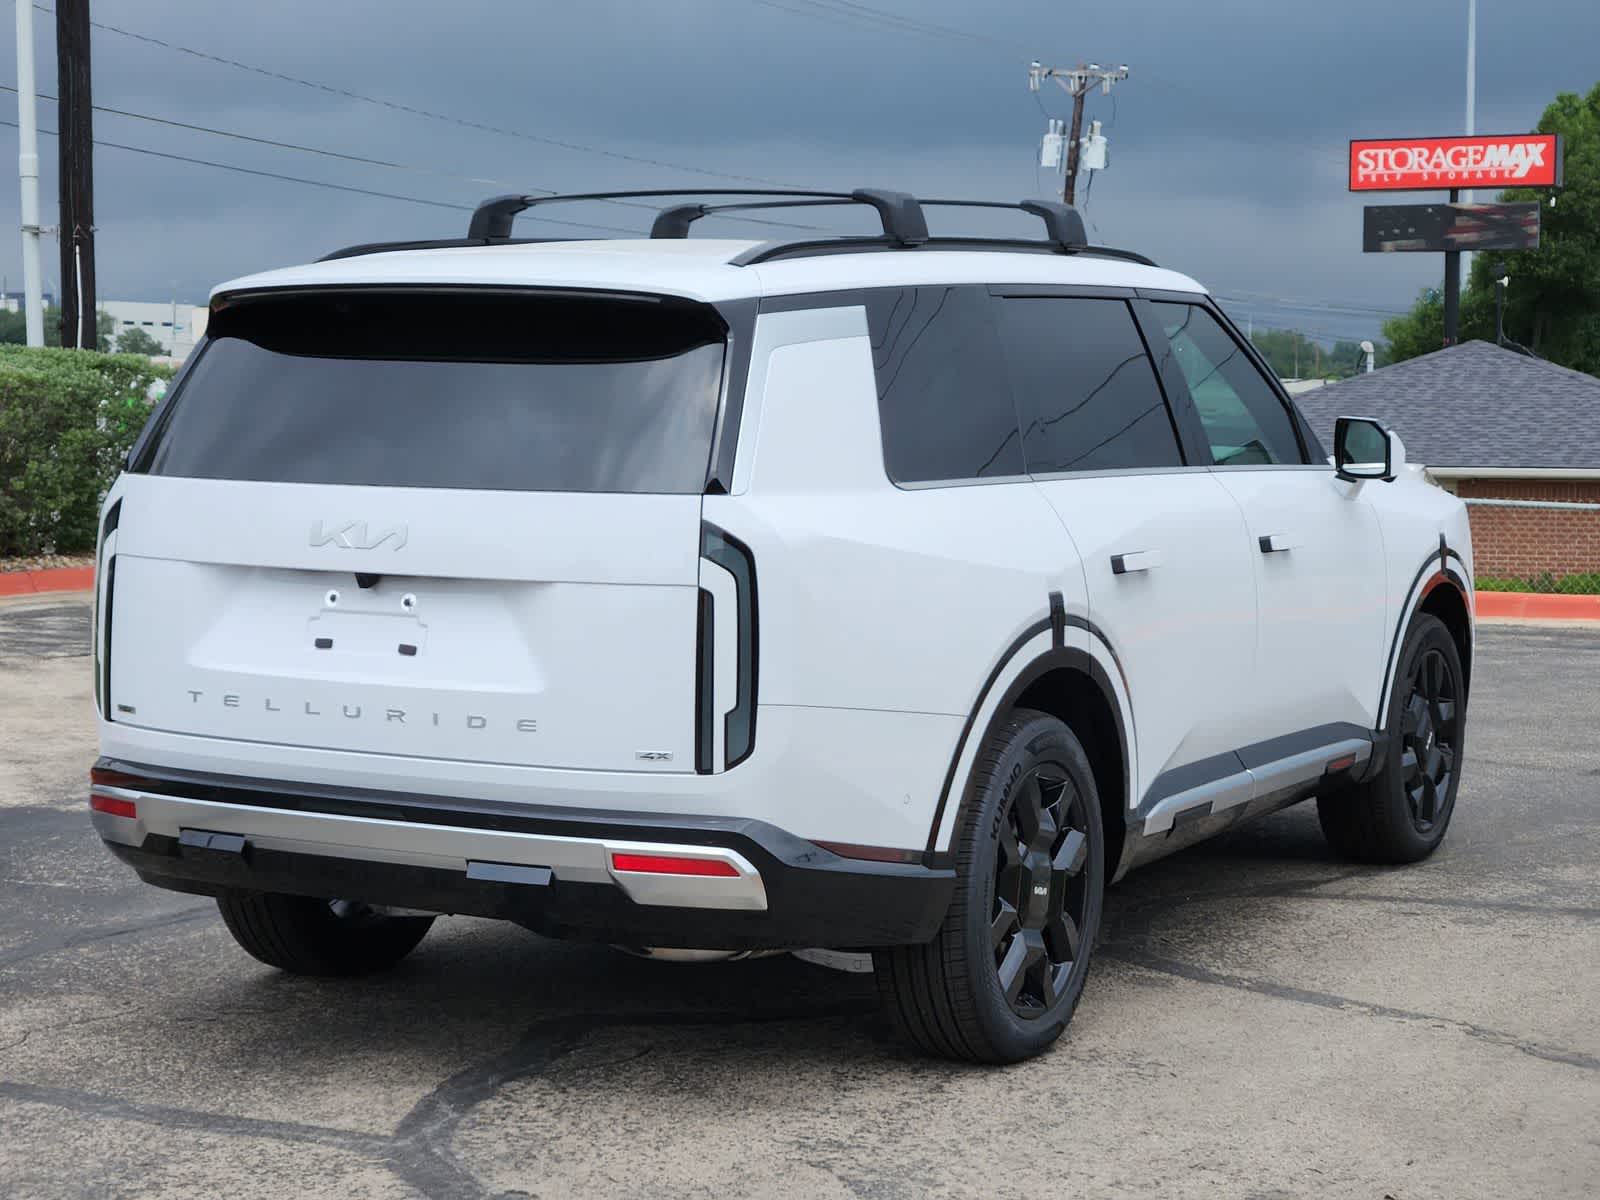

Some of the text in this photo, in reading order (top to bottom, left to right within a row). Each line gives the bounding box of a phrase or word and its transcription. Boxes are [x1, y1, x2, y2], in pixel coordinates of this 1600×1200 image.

[1423, 170, 1511, 180] STORAGE
[309, 520, 409, 551] KIA
[187, 690, 537, 732] TELLURIDE
[990, 762, 1022, 840] KUMHO
